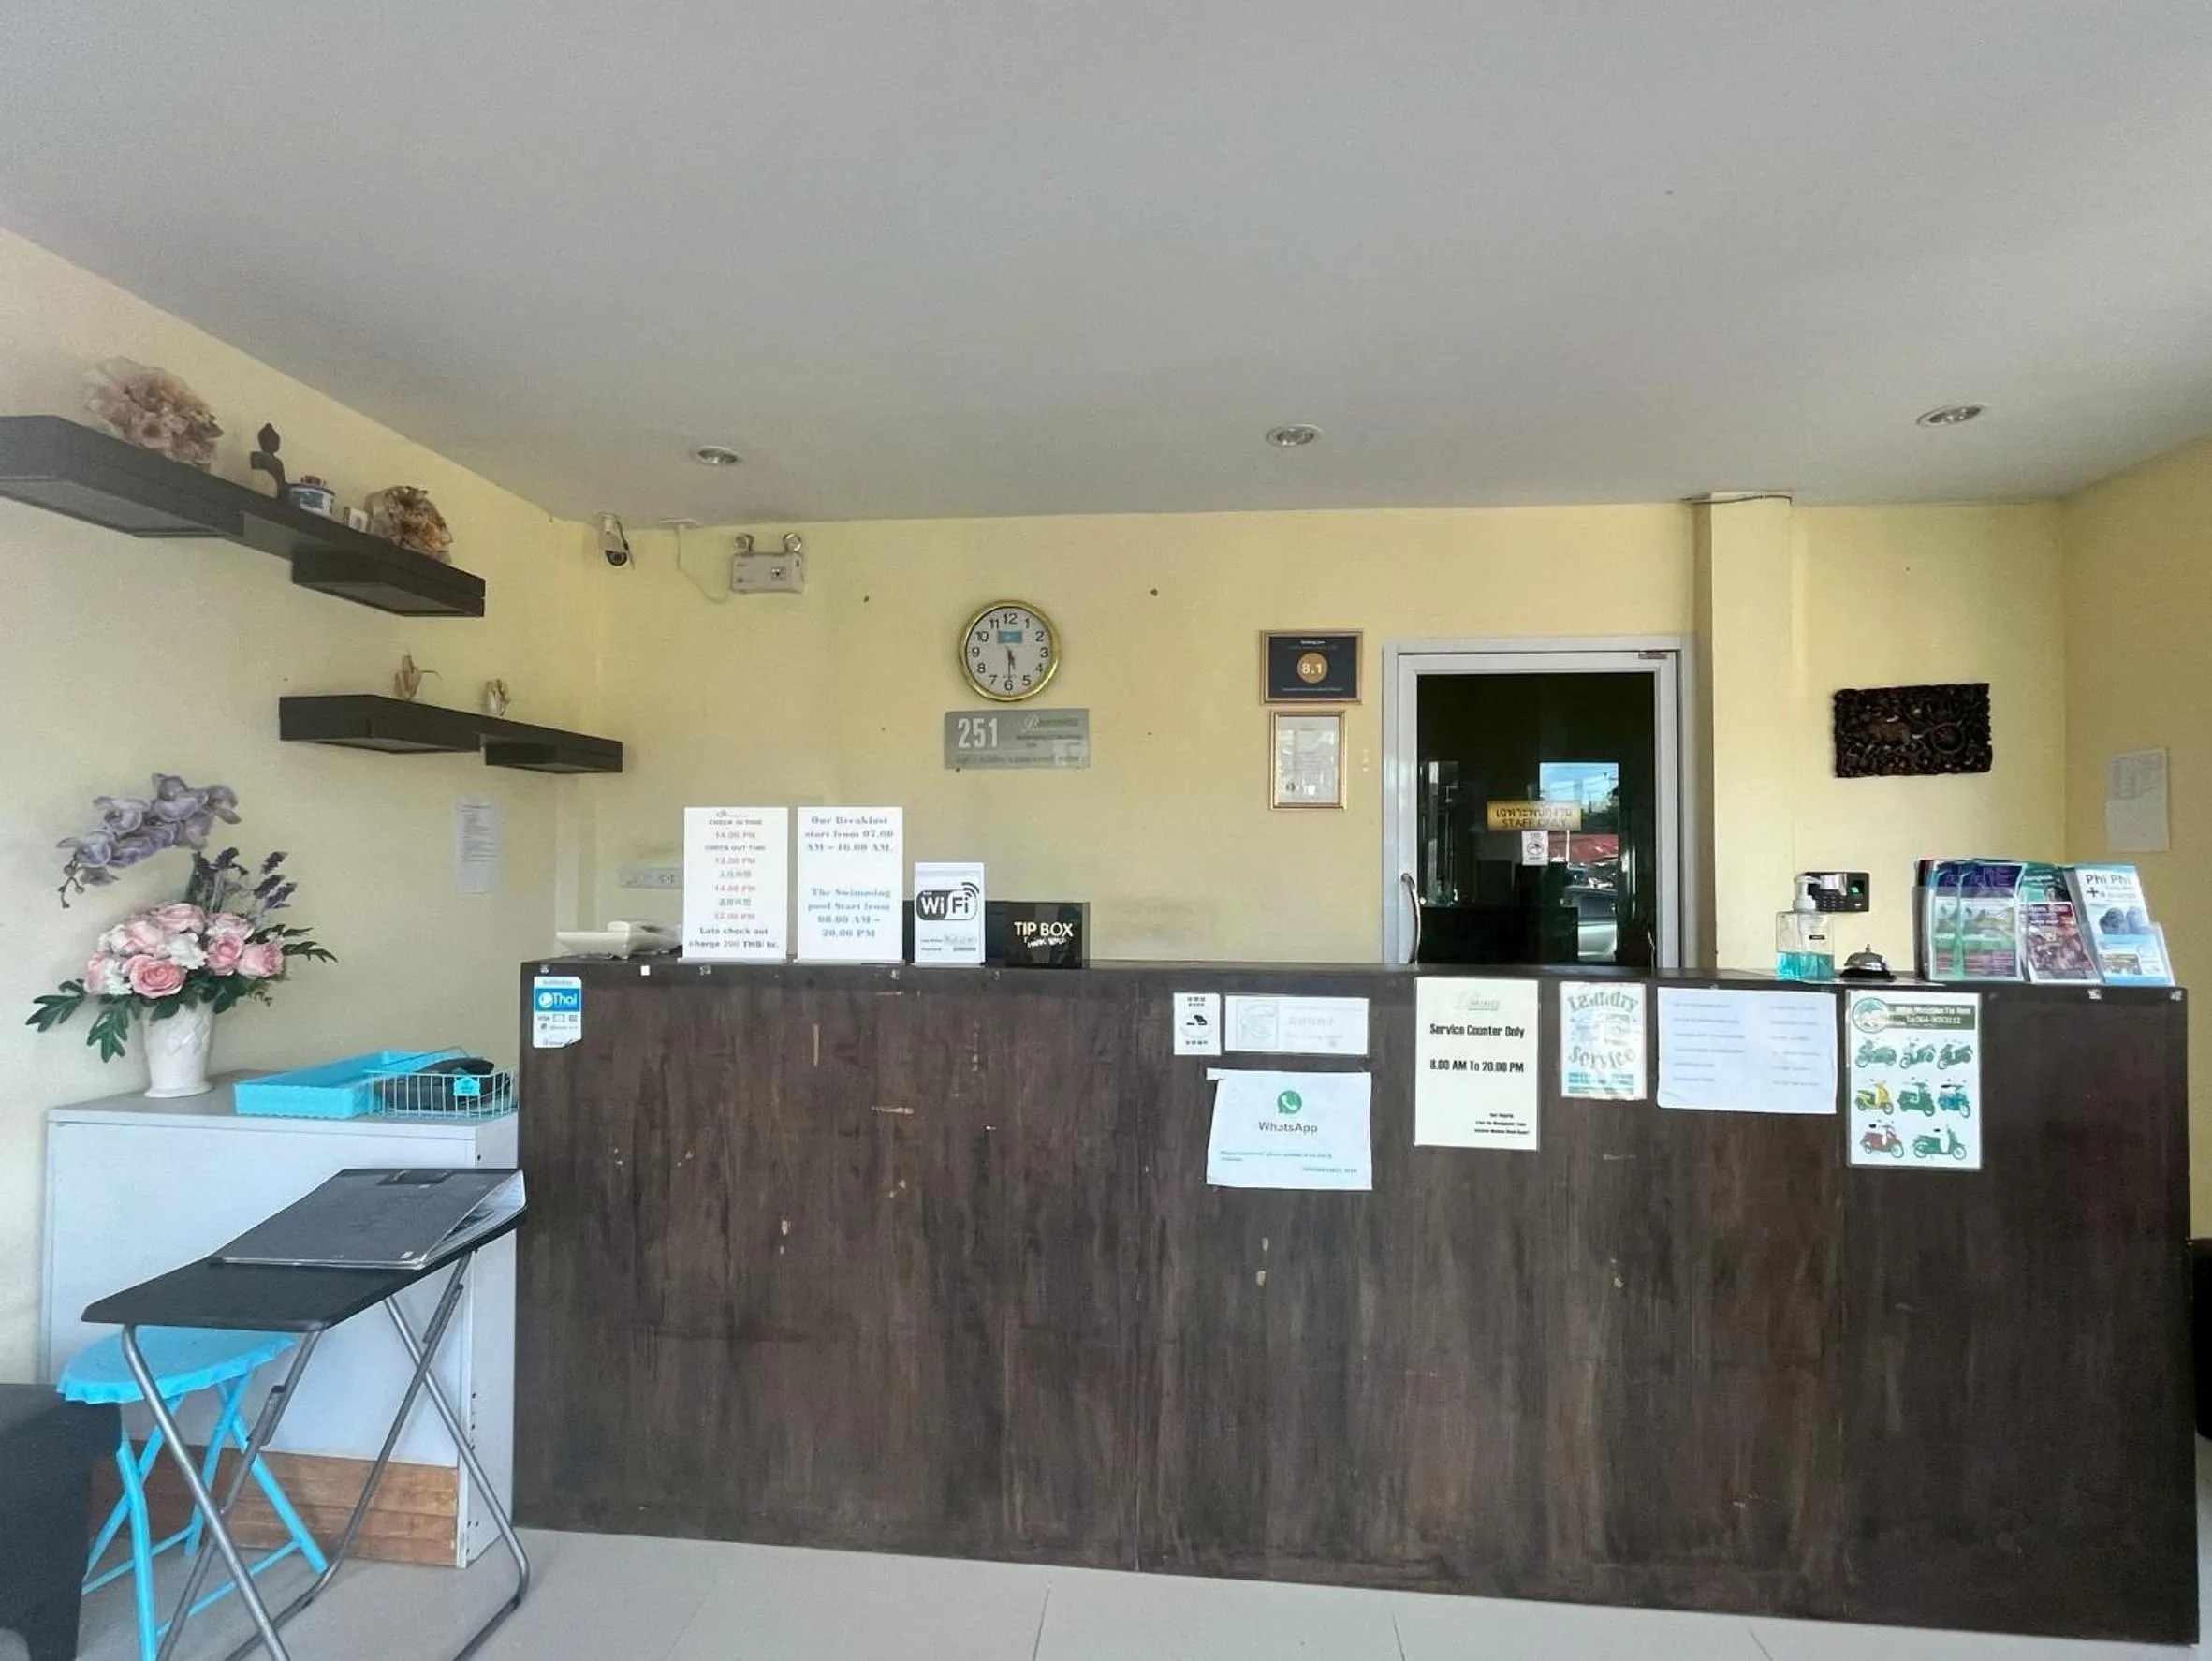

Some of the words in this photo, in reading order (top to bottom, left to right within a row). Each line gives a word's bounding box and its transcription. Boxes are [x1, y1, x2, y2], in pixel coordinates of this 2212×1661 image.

[989, 618, 999, 629] 11
[1003, 612, 1018, 625] 12
[975, 631, 989, 642] 10
[1035, 631, 1045, 642] 2
[972, 646, 980, 658] 9
[1040, 647, 1048, 658] 3
[977, 662, 986, 674] 8
[1035, 663, 1043, 673] 4
[1301, 662, 1322, 674] 8.1
[989, 674, 998, 686] 7
[1004, 680, 1014, 691] 6
[1022, 675, 1031, 686] 5
[958, 717, 998, 749] 251
[1502, 818, 1533, 828] STAFF
[2086, 874, 2107, 885] Phi
[2111, 875, 2131, 885] Phi
[700, 926, 720, 934] Late
[723, 926, 751, 934] check
[1014, 921, 1037, 936] TIP
[1040, 923, 1074, 938] BOX
[689, 940, 720, 949] charge
[1429, 1023, 1465, 1036] Service
[1467, 1024, 1503, 1036] Counter
[1505, 1026, 1525, 1038] Only
[1429, 1060, 1450, 1070] 8.00
[1453, 1060, 1467, 1071] AM
[1470, 1061, 1480, 1071] To
[1482, 1062, 1508, 1072] 20.00
[1509, 1062, 1524, 1073] PM
[1258, 1122, 1318, 1135] WhatsApp
